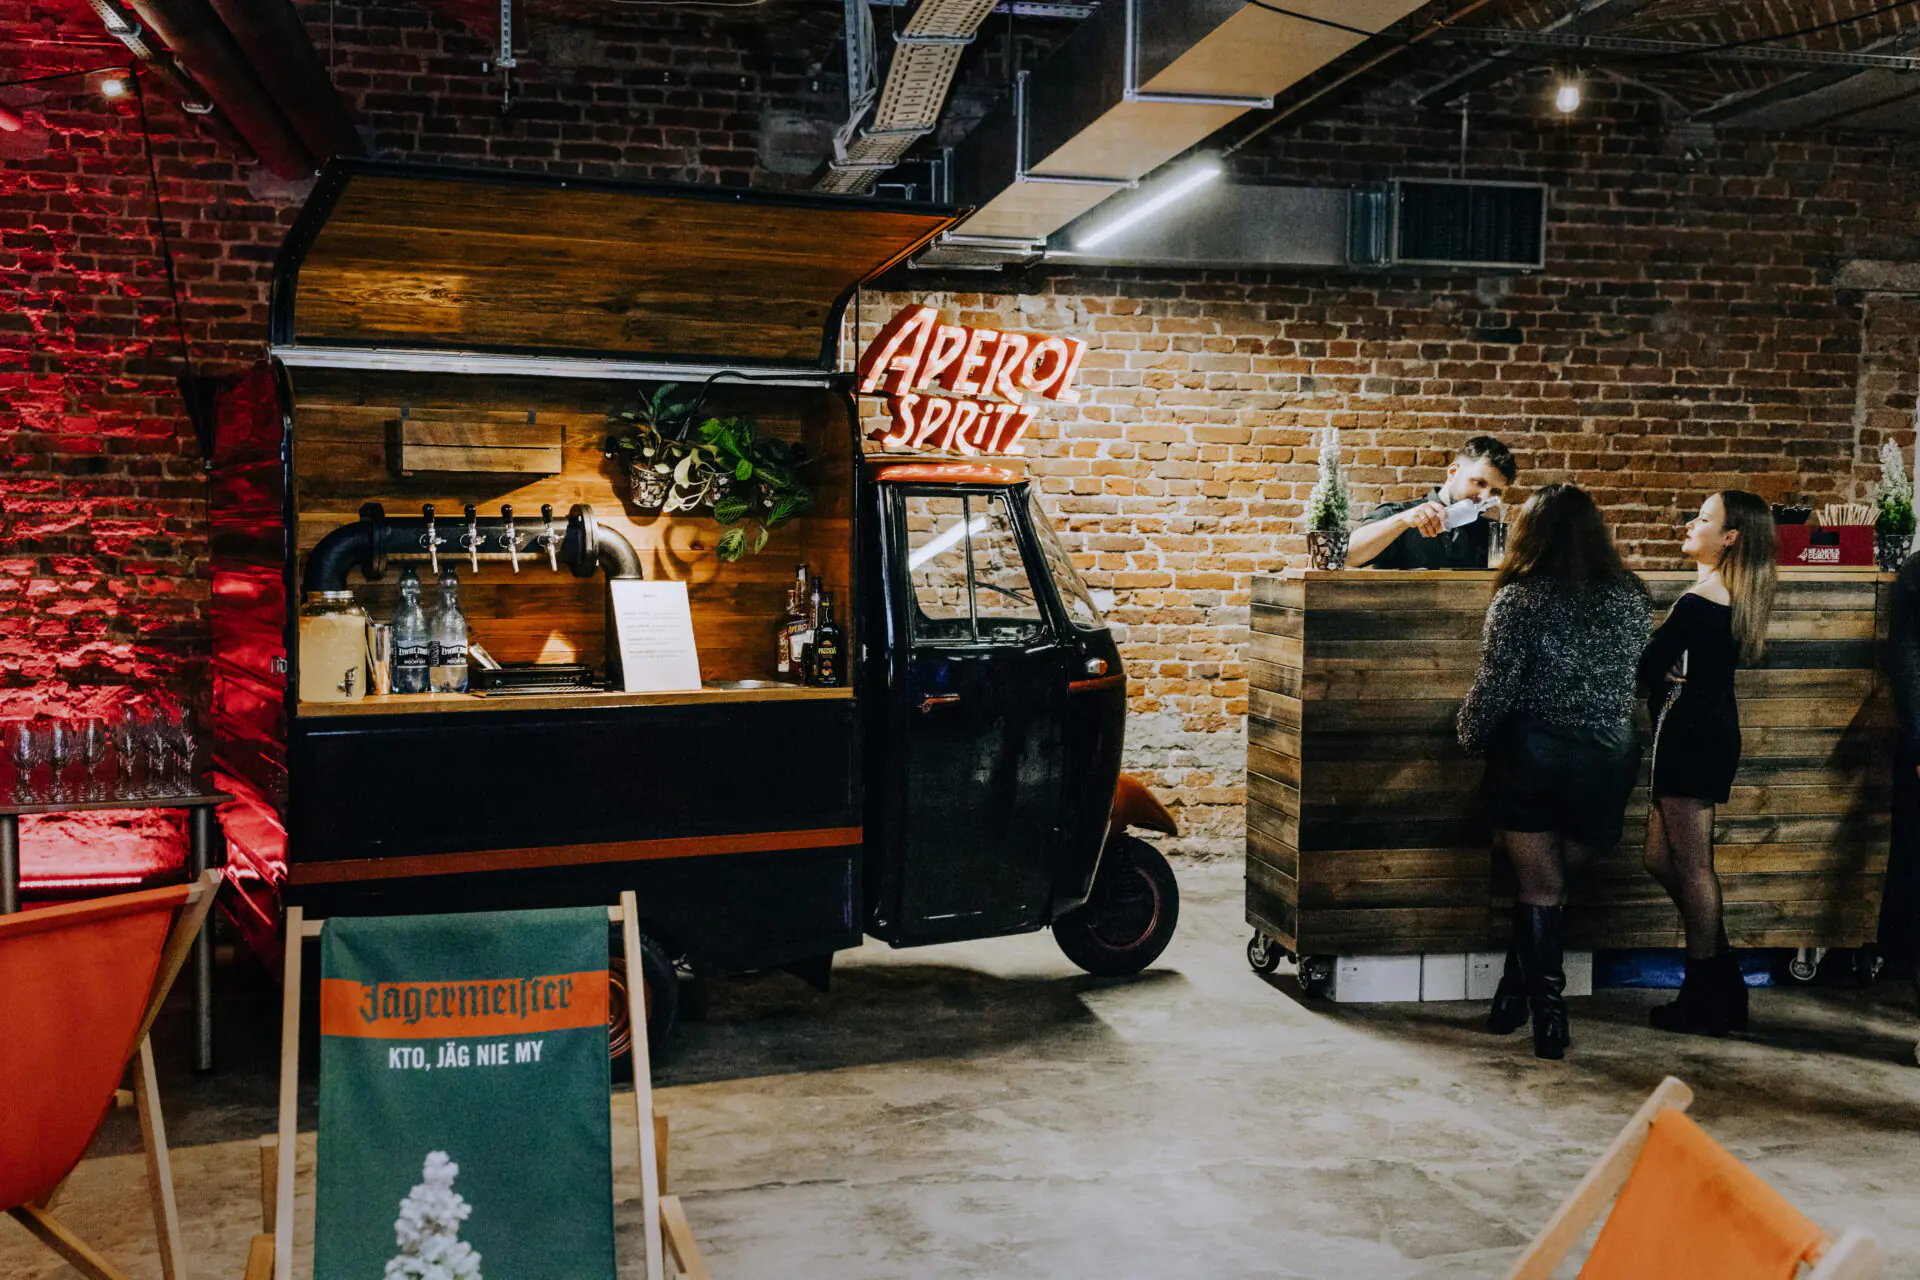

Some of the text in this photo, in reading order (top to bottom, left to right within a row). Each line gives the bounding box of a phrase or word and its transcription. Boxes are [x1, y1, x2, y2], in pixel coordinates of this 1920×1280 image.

[860, 307, 1088, 404] APEROL
[788, 624, 808, 634] APERO
[360, 977, 573, 1024] Jägermeister
[389, 1040, 543, 1071] KTO, JÄG NIE MY
